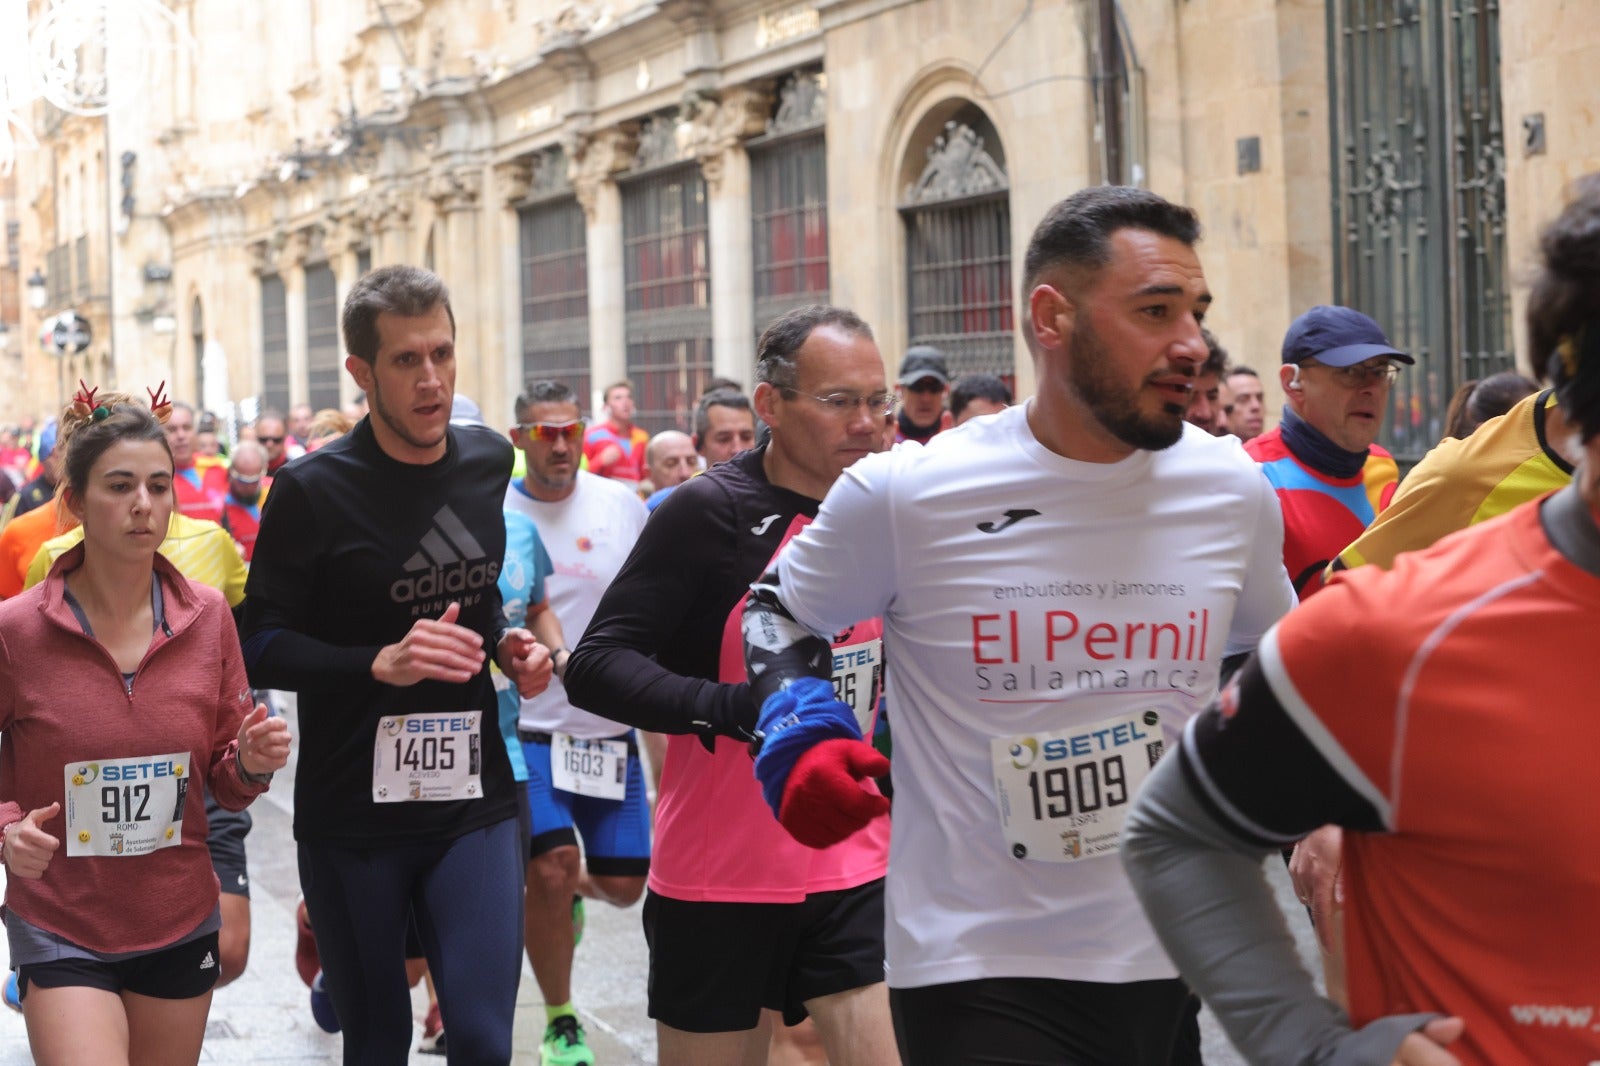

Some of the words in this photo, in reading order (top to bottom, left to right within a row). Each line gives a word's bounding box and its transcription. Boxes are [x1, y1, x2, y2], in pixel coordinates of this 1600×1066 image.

[390, 560, 498, 602] adidas
[994, 580, 1092, 600] embutidos
[1097, 584, 1109, 600] y
[1112, 579, 1186, 599] jamones
[972, 610, 1019, 664] El
[1045, 609, 1209, 662] Pernil
[832, 649, 875, 671] ETEL
[975, 664, 1199, 692] Salamanca
[406, 718, 471, 733] SETEL
[394, 737, 455, 771] 1405
[1043, 721, 1146, 761] SETEL
[102, 761, 176, 781] SETEL
[565, 750, 604, 777] 1603
[1029, 754, 1128, 821] 1909
[101, 784, 151, 823] 912
[116, 823, 139, 831] ROMO
